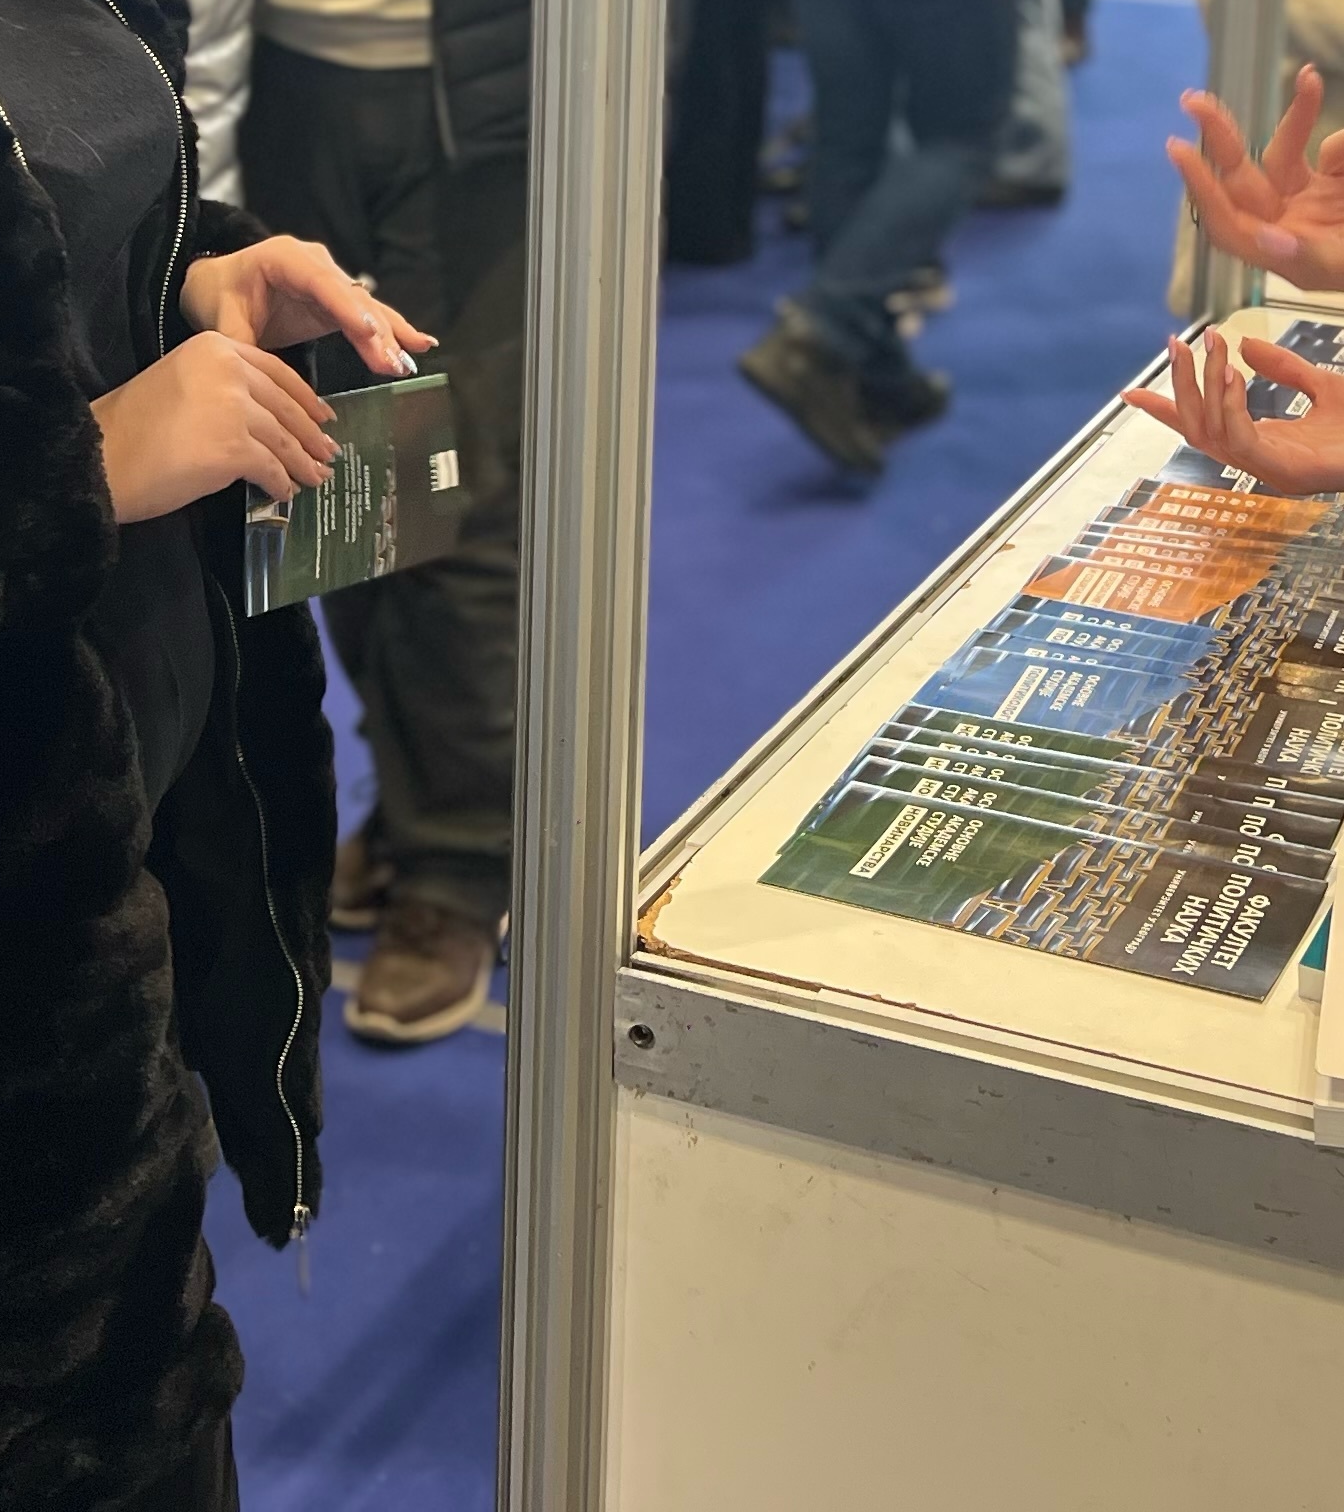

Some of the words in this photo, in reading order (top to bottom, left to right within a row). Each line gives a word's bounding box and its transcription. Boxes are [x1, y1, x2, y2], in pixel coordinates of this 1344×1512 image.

[1276, 727, 1312, 762] НАУКА
[856, 806, 922, 875] НОВИНАРСТВА
[908, 811, 946, 849] СТУДИЈЕ
[915, 814, 965, 868] АКАДЕМСКЕ
[942, 819, 984, 863] ОСНОВНЕ
[1160, 894, 1210, 944] НАУКА
[1171, 872, 1253, 976] ПОЛИТИЧКИХ
[1210, 894, 1271, 971] ФАКУЛТЕТ
